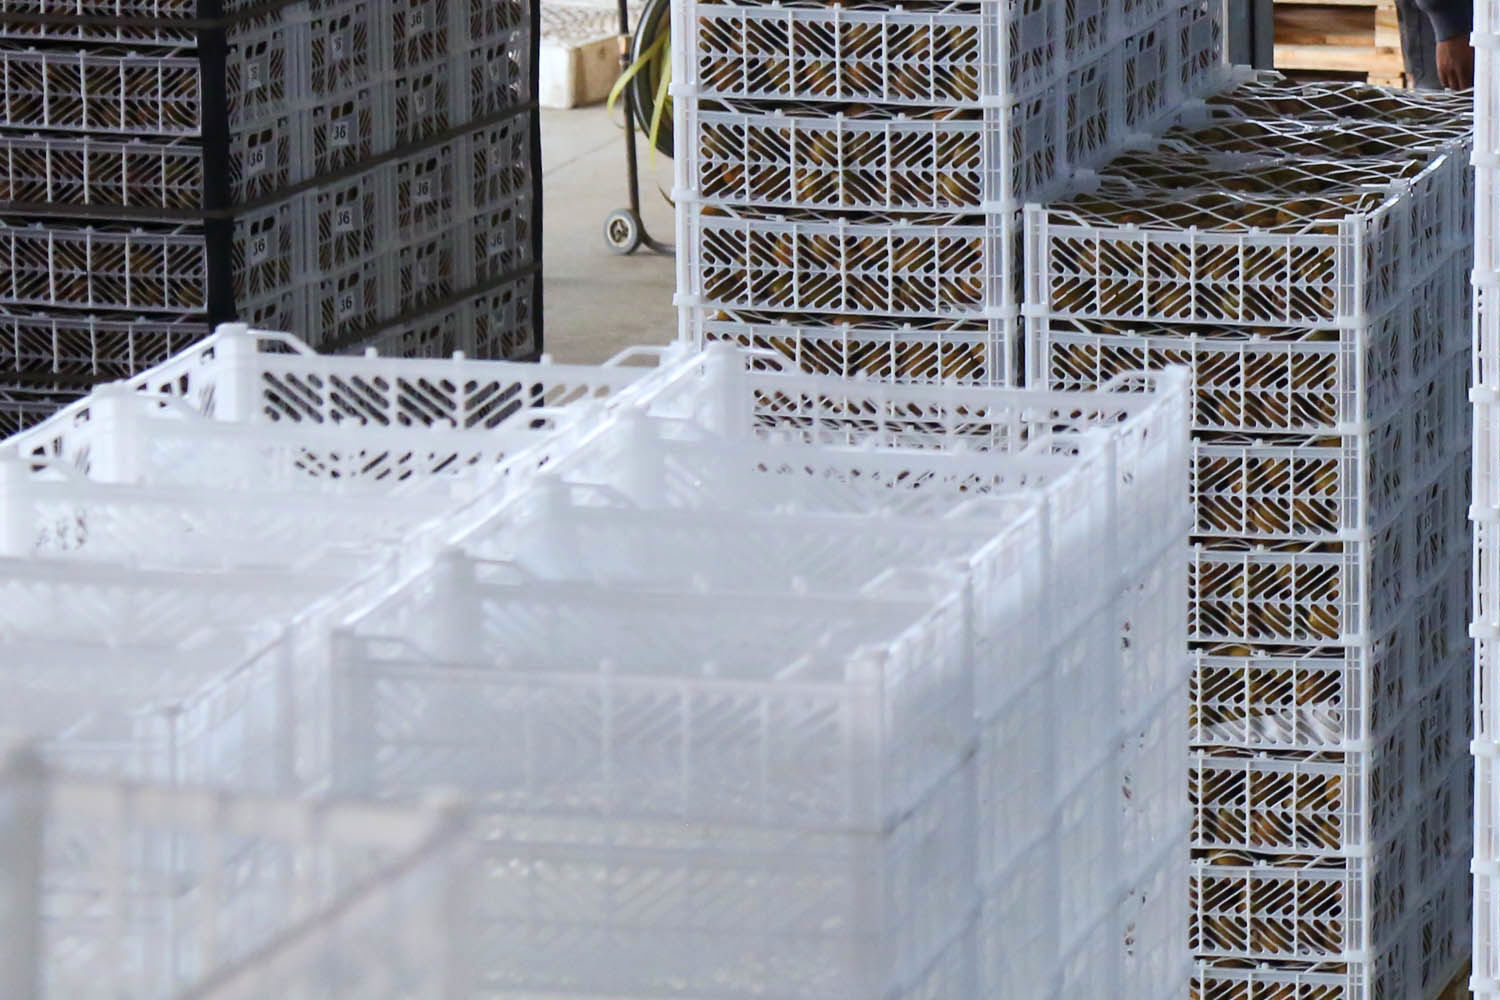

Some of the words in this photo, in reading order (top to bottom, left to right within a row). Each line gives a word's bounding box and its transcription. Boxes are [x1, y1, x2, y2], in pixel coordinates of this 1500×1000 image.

[333, 125, 346, 140] 36
[250, 150, 263, 167] 36
[417, 181, 429, 196] 36
[337, 210, 350, 226] 36
[254, 238, 265, 256] 36
[340, 296, 352, 313] 36
